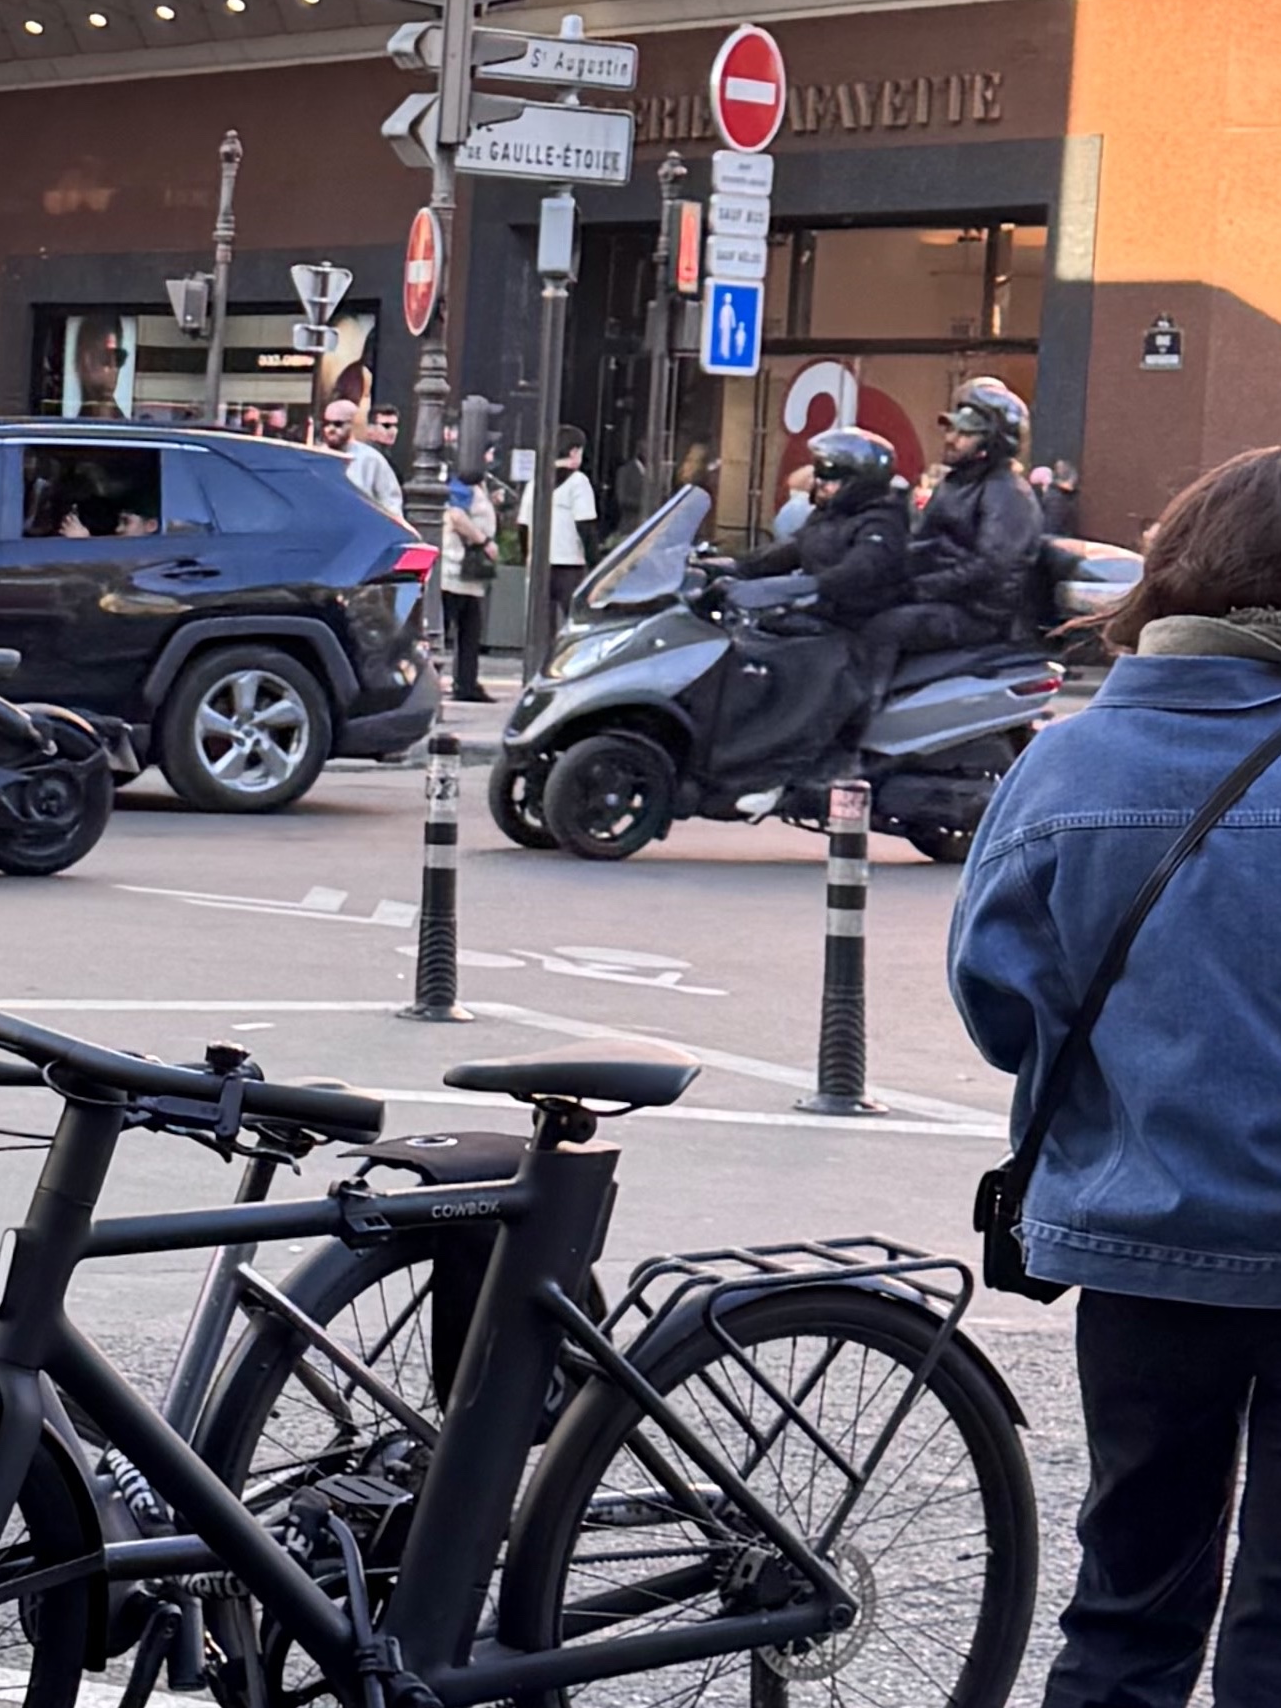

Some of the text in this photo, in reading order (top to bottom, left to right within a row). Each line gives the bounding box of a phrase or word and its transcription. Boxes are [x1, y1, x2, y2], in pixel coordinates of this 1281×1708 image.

[554, 51, 629, 79] Augustin
[785, 72, 1003, 133] AFAYETTE
[488, 142, 622, 173] GAULLE-ÉTOILE
